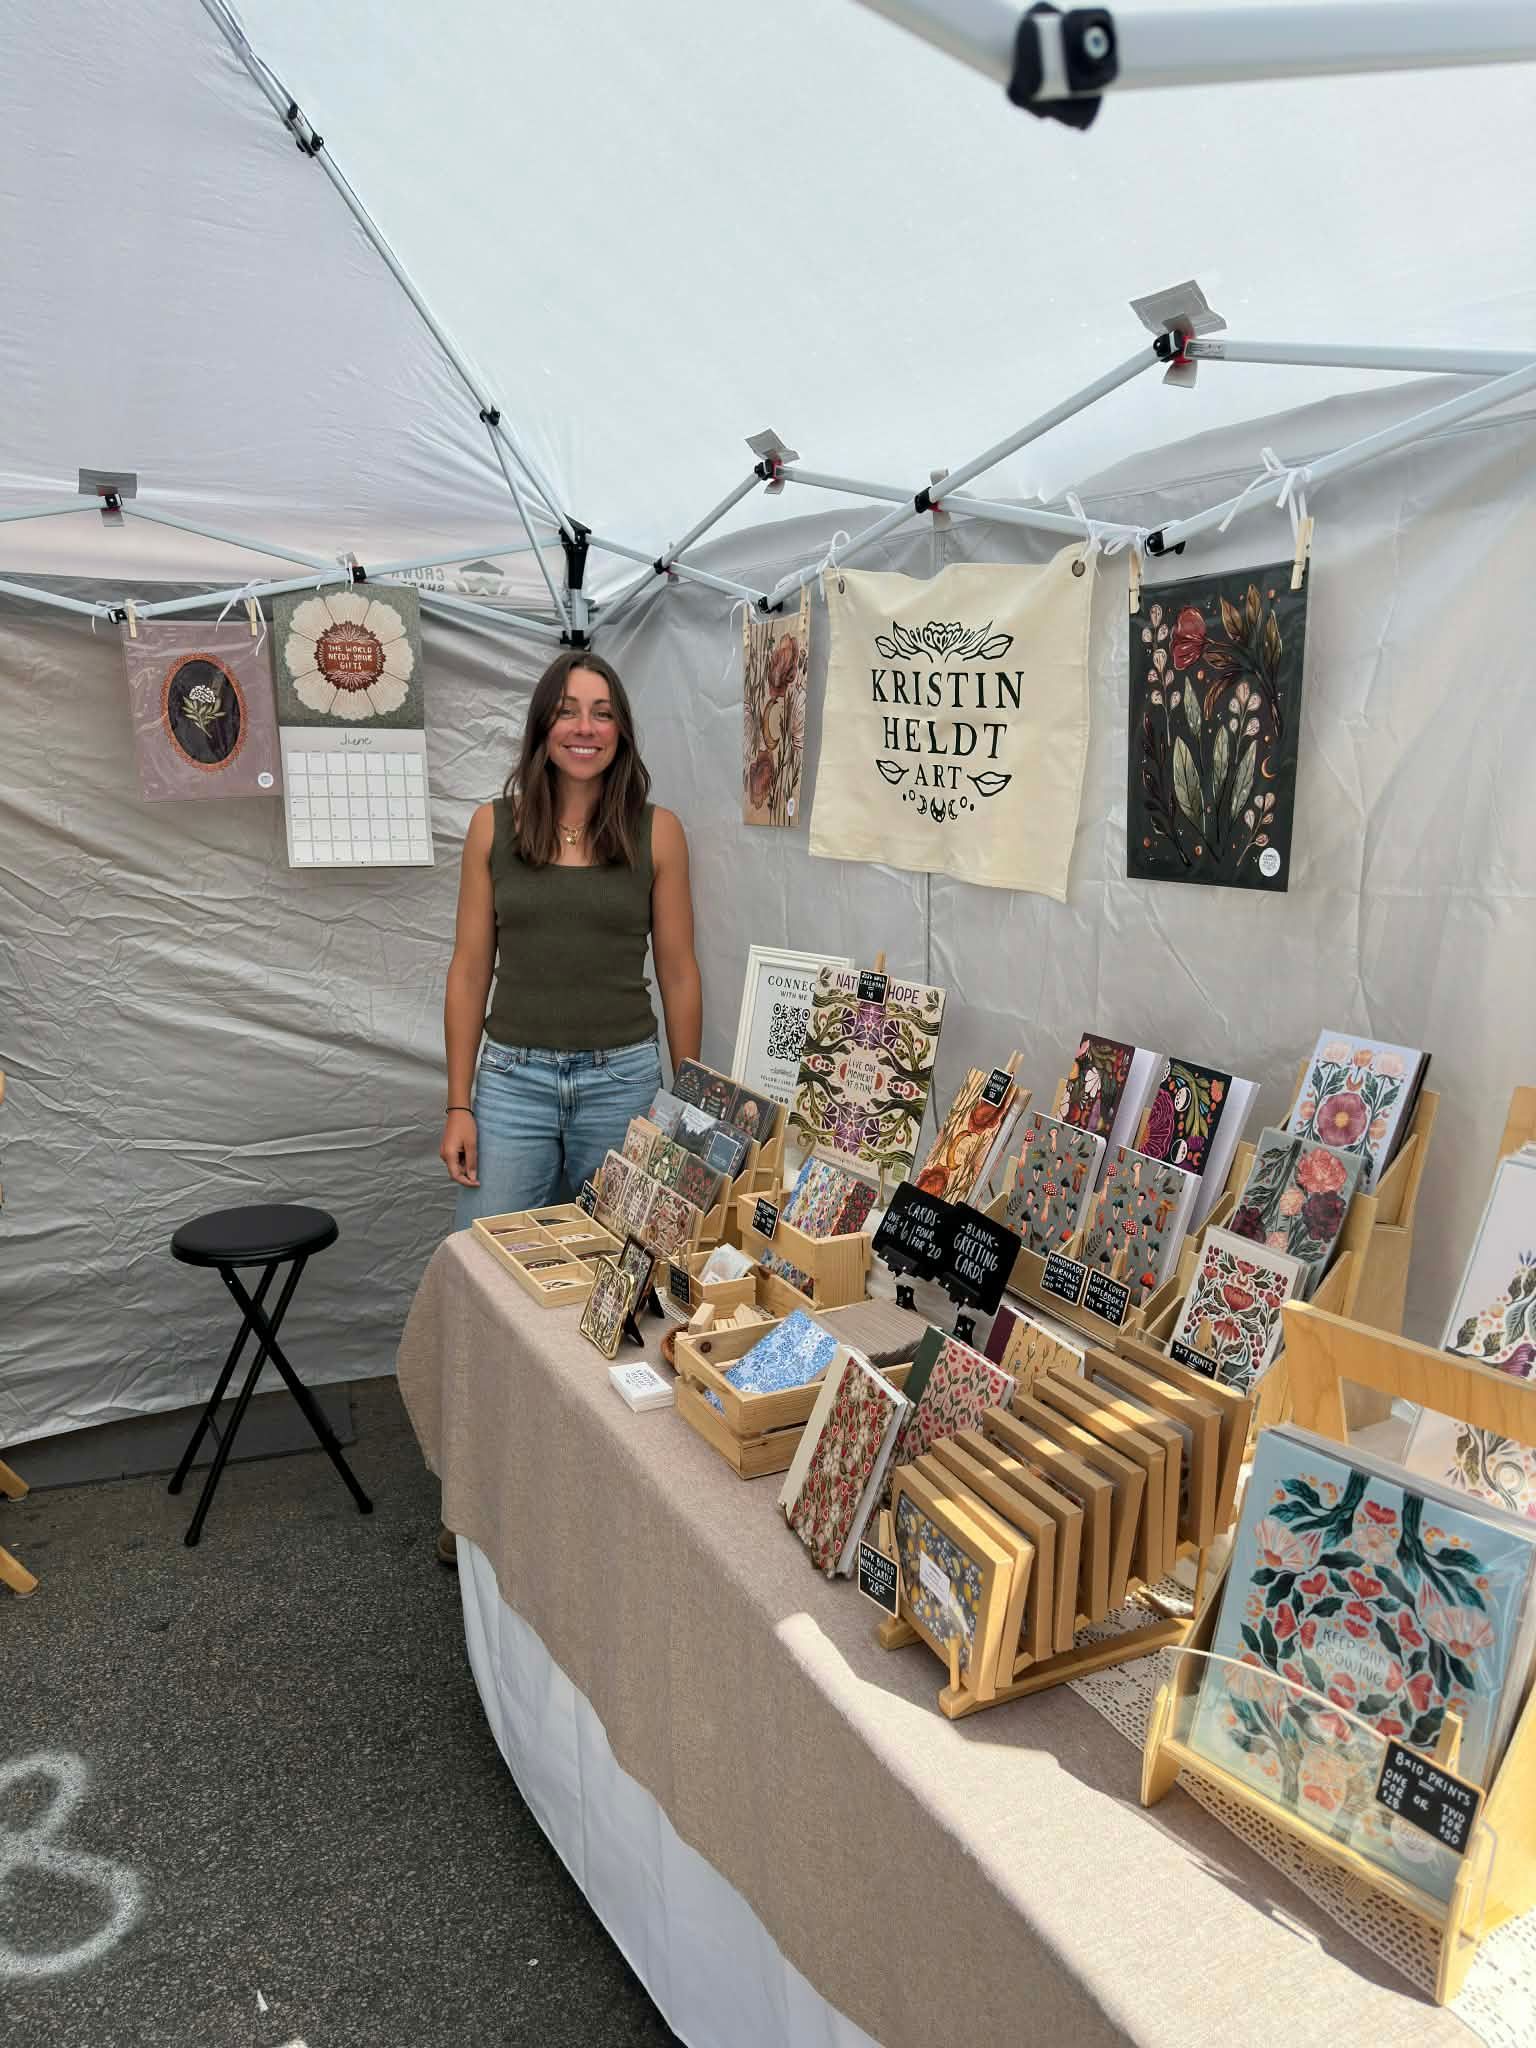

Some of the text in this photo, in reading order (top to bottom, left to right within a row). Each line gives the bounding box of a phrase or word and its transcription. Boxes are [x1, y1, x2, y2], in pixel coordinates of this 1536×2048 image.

[327, 653, 350, 661] NEEDS
[328, 644, 373, 654] THE WORLD
[340, 661, 362, 670] GIFTS
[871, 669, 1024, 709] KRISTIN
[882, 716, 1007, 759] HELDT
[915, 763, 962, 790] ART
[768, 975, 815, 993] CONNEC
[780, 990, 808, 1001] WITH ME
[848, 1057, 864, 1070] LIVE
[847, 1069, 874, 1085] MOMENT
[888, 1210, 901, 1224] ONE
[883, 1220, 897, 1235] FOR
[916, 1225, 935, 1242] FOUR
[911, 1236, 925, 1252] FOR
[954, 1232, 998, 1272] GREETING
[955, 1254, 985, 1285] CARDS
[1047, 1265, 1080, 1284] JOURNALS
[1050, 1255, 1084, 1275] HANDMADE
[1089, 1284, 1124, 1308] NOTEBOOKS
[1092, 1274, 1126, 1299] SOFT COVER
[1190, 1352, 1213, 1372] PRINTS
[860, 1557, 893, 1585] NOTECARDS
[876, 1556, 895, 1576] BOXED
[1322, 1627, 1356, 1649] KEEP
[1316, 1641, 1383, 1687] GROWING
[1382, 1778, 1404, 1800] FOR
[1385, 1769, 1409, 1789] ONE
[1428, 1771, 1471, 1807] PRINTS
[1413, 1795, 1430, 1811] OR
[1441, 1803, 1466, 1824] TWO
[1441, 1815, 1463, 1835] FOR
